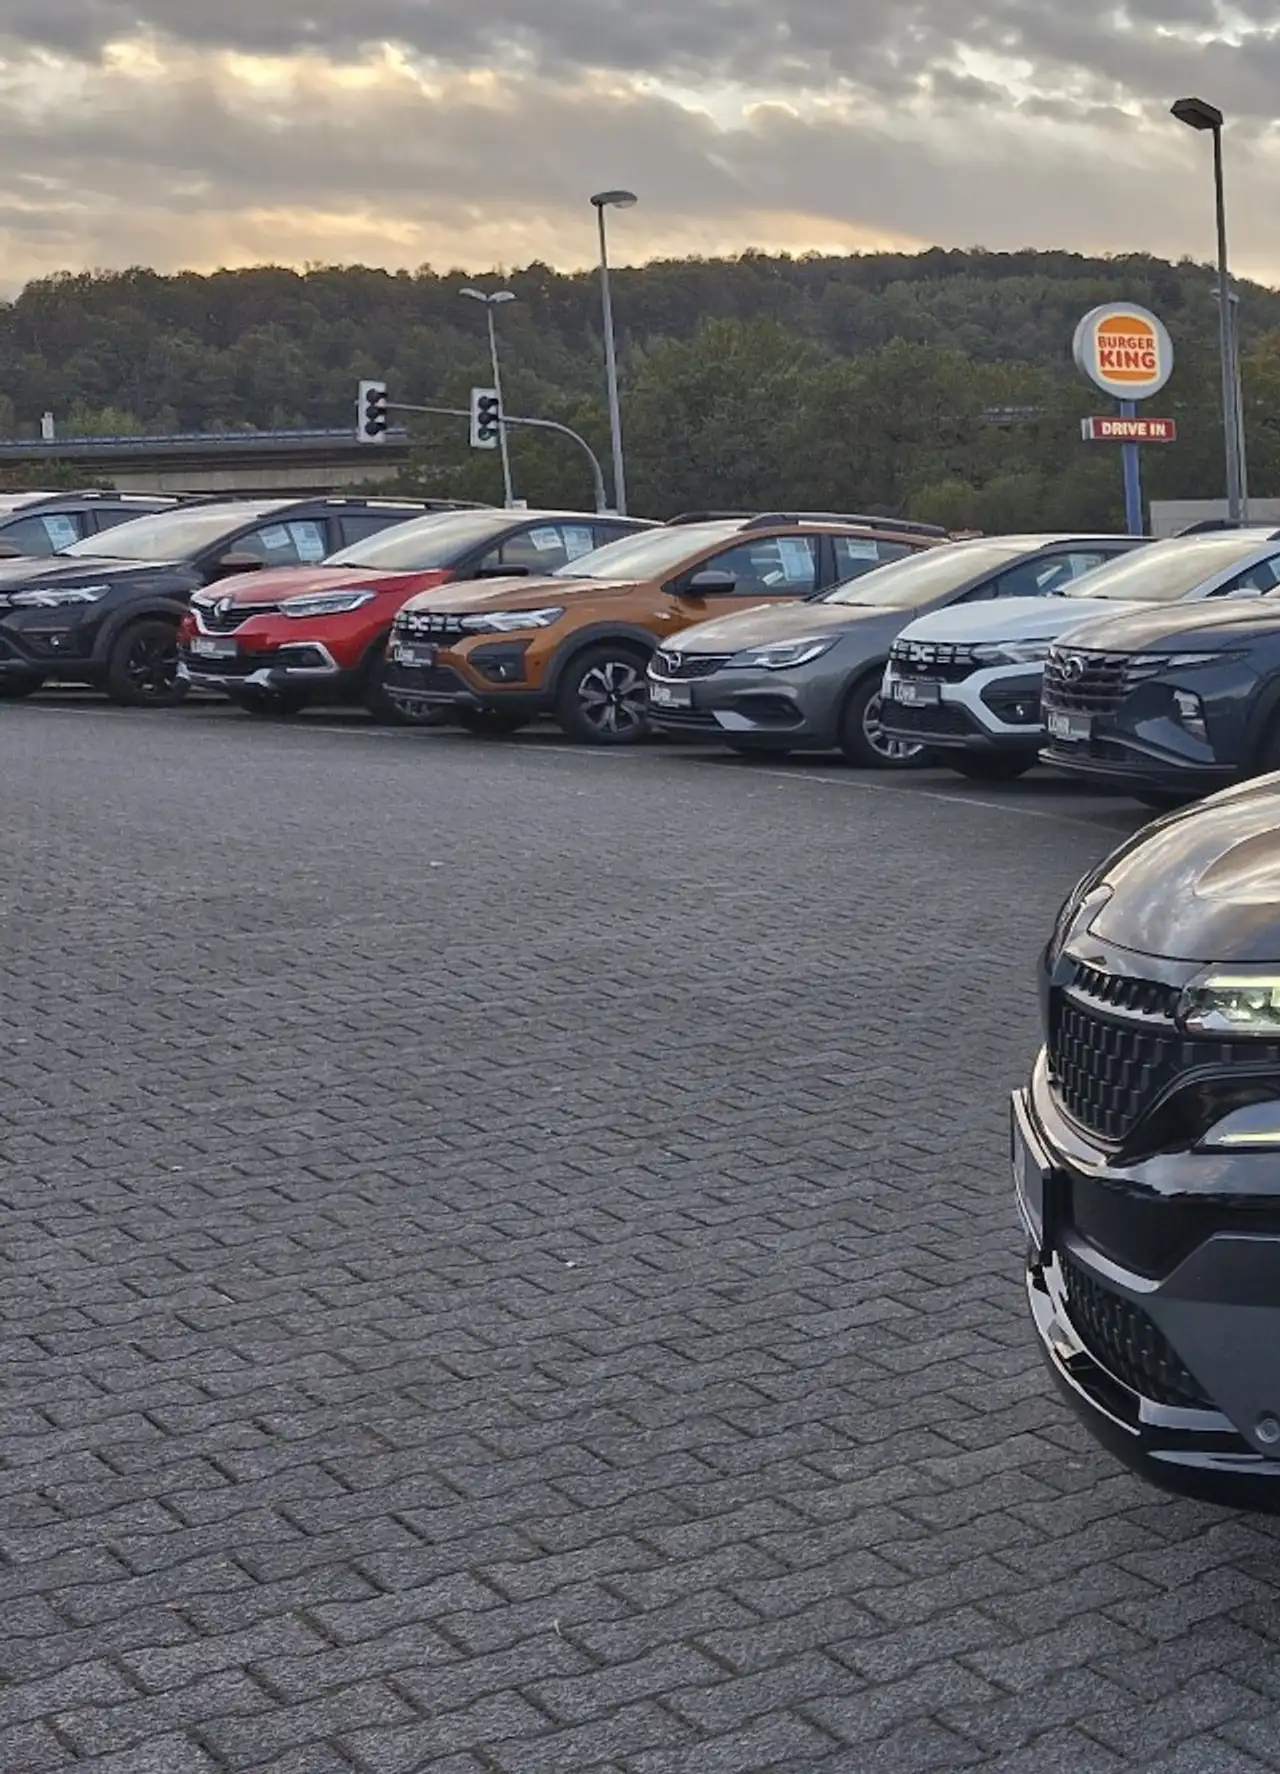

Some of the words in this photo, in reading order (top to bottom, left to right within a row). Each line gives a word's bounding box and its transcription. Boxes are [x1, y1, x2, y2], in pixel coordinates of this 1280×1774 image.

[1098, 336, 1155, 350] BURGER
[1099, 350, 1157, 369] KING
[1101, 422, 1147, 436] DRIVE
[1150, 423, 1166, 436] IN
